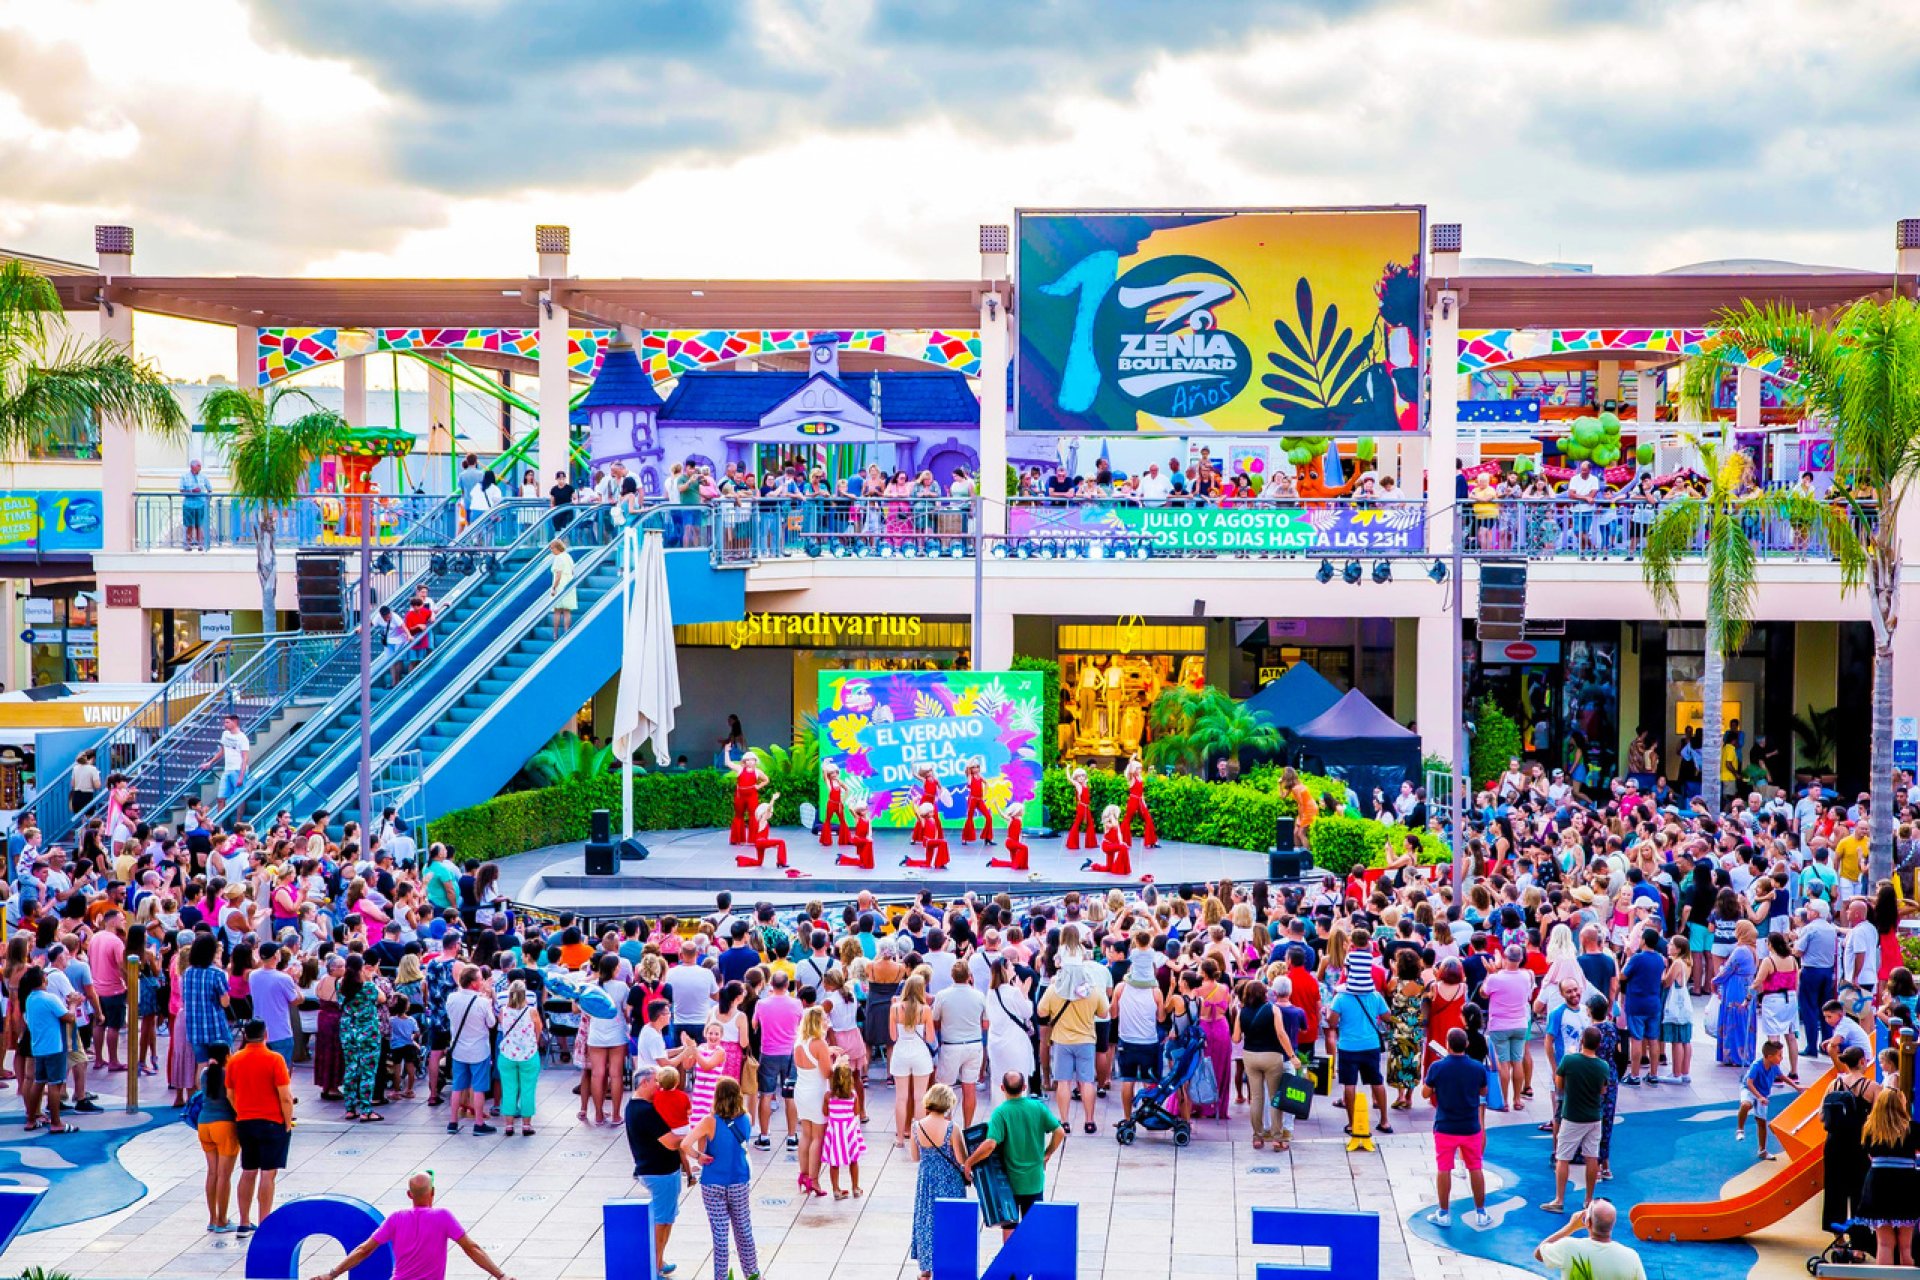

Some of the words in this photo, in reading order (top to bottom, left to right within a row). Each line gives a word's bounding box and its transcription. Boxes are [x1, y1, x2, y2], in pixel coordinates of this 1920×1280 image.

[1119, 334, 1236, 358] ZENIA
[1117, 357, 1238, 372] BOULEVARD
[1172, 380, 1234, 416] Años
[4, 499, 31, 511] BALL
[5, 510, 33, 522] TIME
[1142, 513, 1193, 530] JULIO
[1198, 513, 1209, 528] Y
[1214, 513, 1290, 528] AGOSTO
[0, 524, 31, 535] RIZES
[1183, 531, 1216, 546] LOS
[1223, 532, 1265, 546] DIAS
[1270, 532, 1332, 546] HASTA
[1335, 532, 1369, 546] LAS
[1373, 532, 1408, 547] 23H
[202, 624, 230, 633] mayka
[748, 612, 921, 636] stradivarius
[1261, 668, 1286, 678] ATM
[877, 728, 900, 746] EL
[900, 719, 984, 744] VERANO
[901, 743, 928, 763] DE
[930, 741, 957, 759] LA
